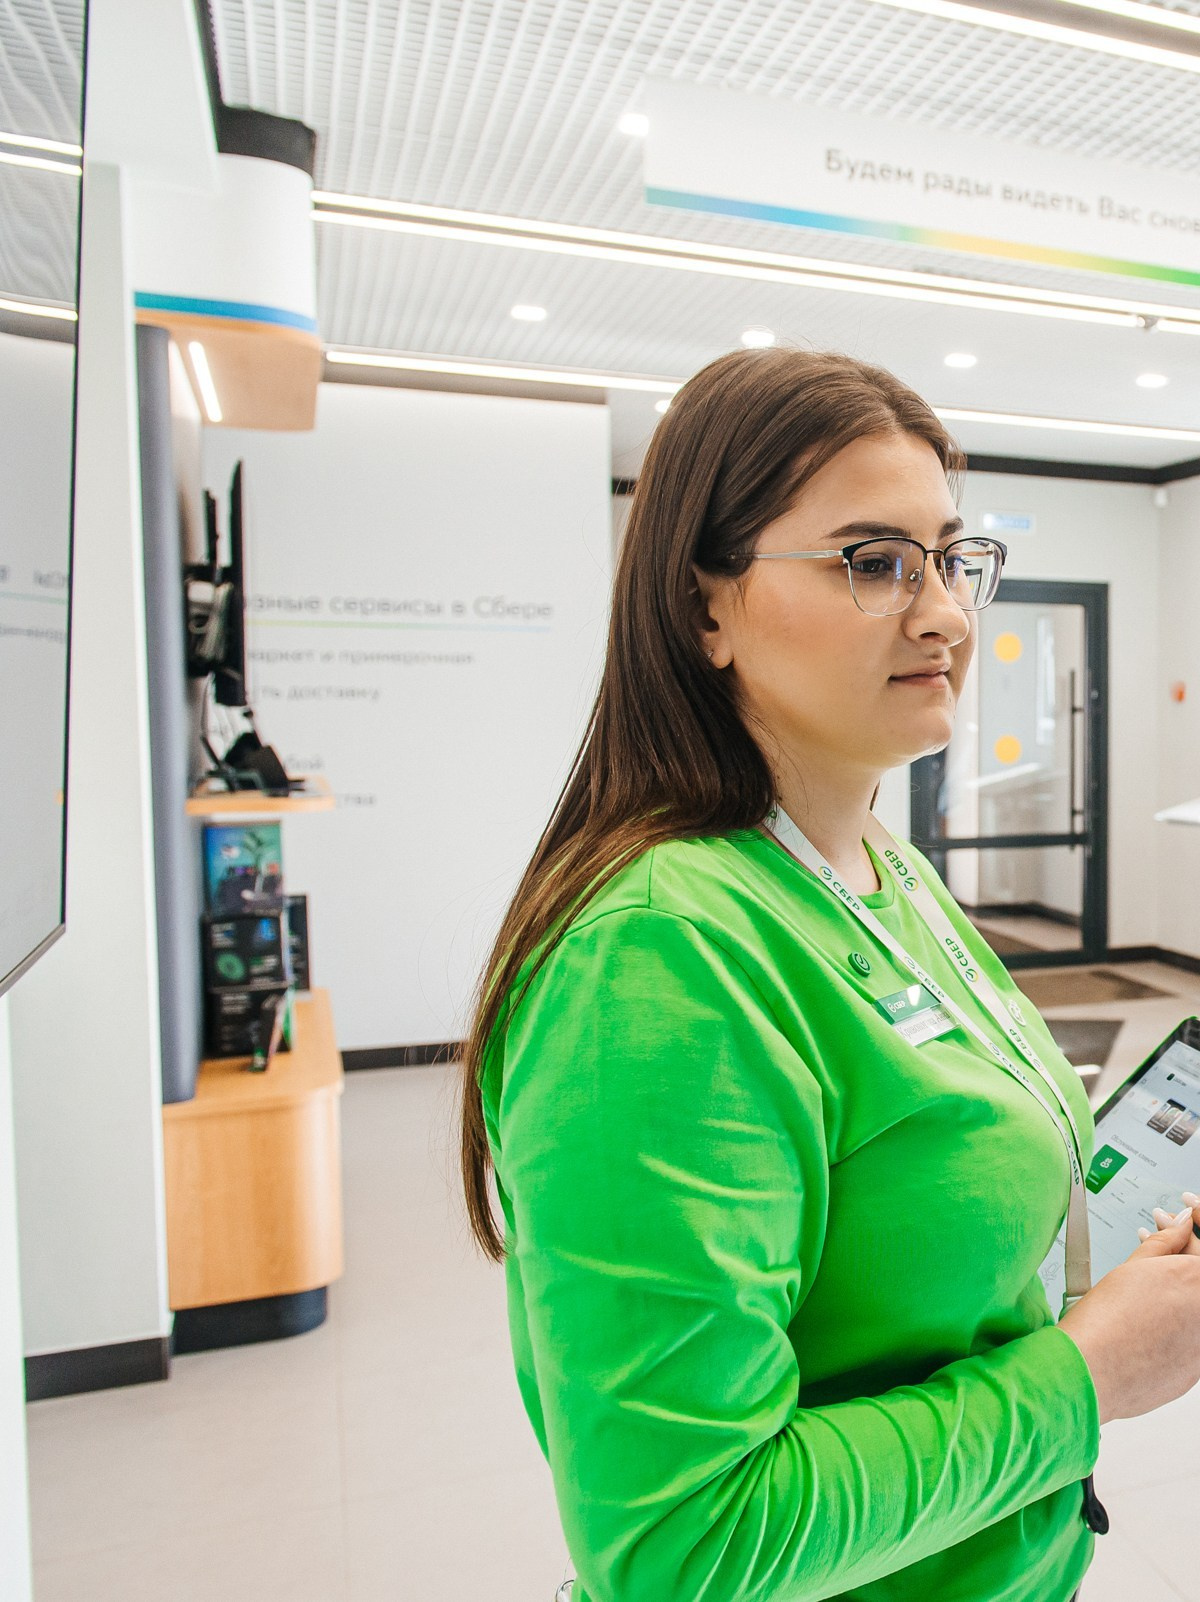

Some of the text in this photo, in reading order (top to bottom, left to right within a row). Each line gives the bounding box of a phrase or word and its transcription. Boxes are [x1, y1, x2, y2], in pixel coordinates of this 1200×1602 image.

[825, 148, 914, 184] Будем
[923, 171, 993, 198] рады
[1001, 185, 1089, 217] видеть
[1098, 195, 1142, 226] Вас
[329, 597, 443, 618] сервисы
[451, 601, 466, 617] в
[473, 595, 552, 621] Сбере
[884, 849, 908, 877] СБЕР
[832, 881, 861, 911] СБЕР
[945, 937, 969, 967] СБЕР
[917, 971, 945, 998] СБЕР
[1009, 1028, 1032, 1057] СБЕР
[1002, 1057, 1029, 1083] СБЕР
